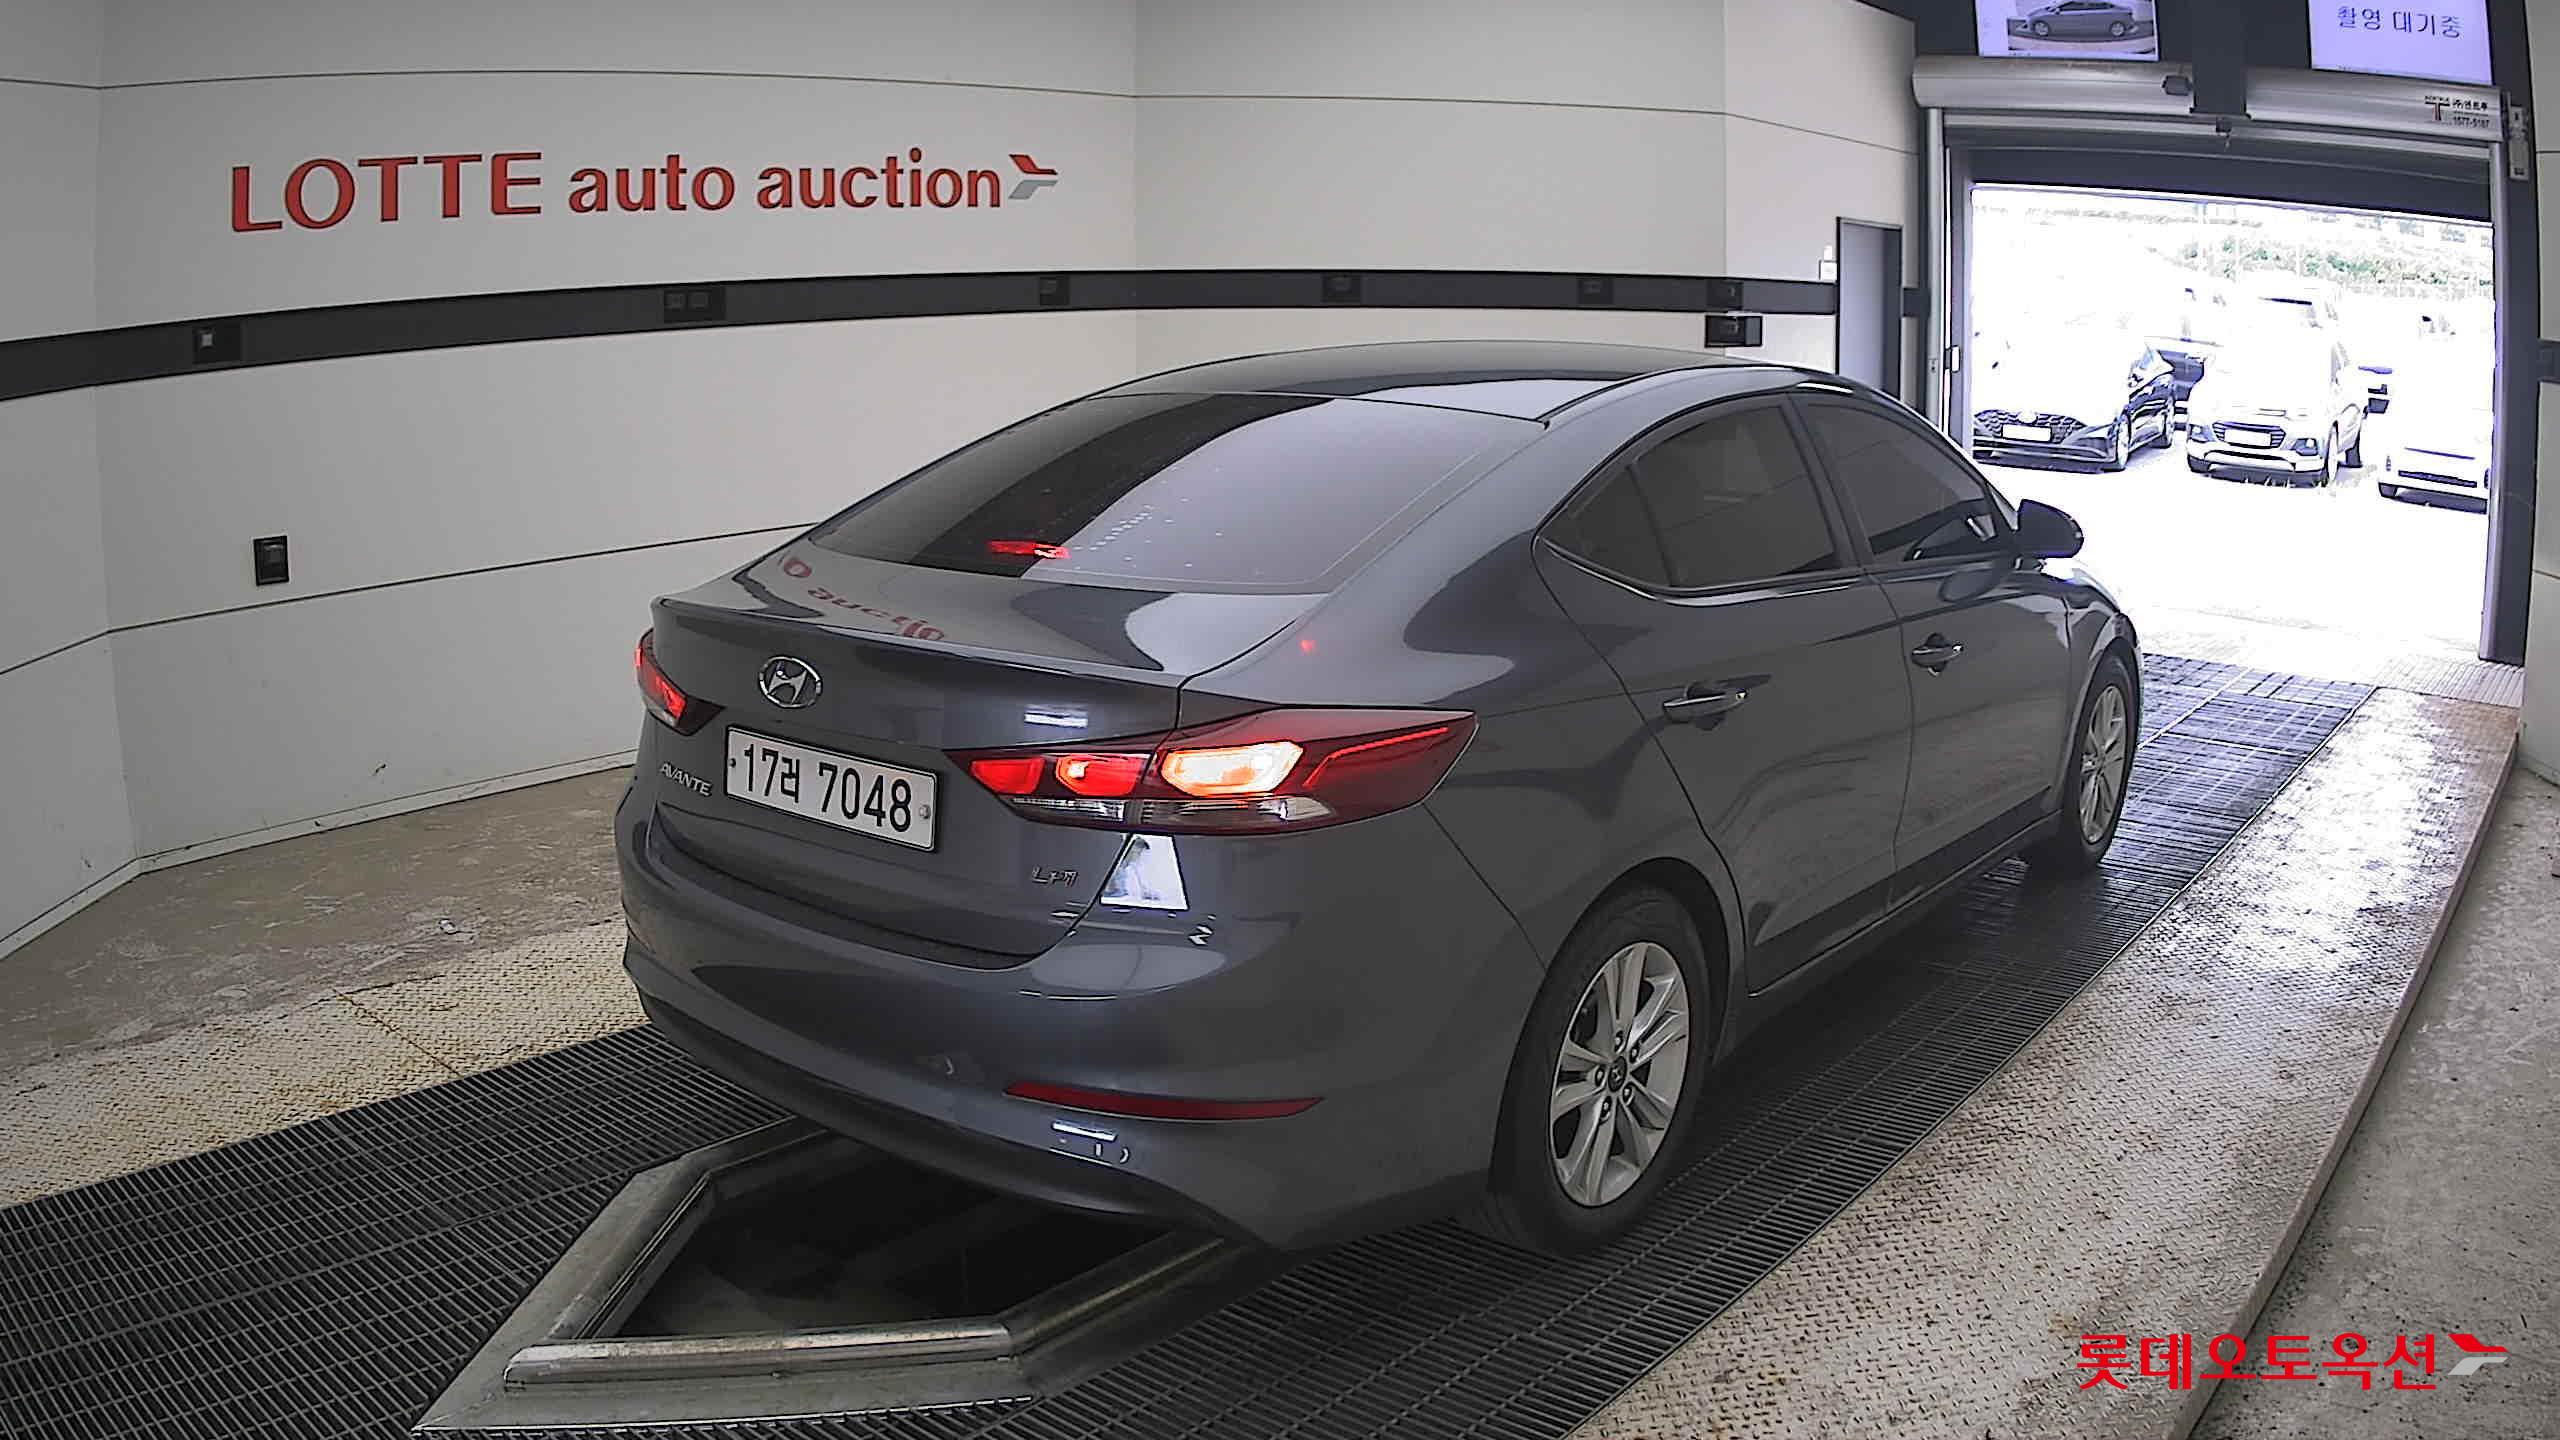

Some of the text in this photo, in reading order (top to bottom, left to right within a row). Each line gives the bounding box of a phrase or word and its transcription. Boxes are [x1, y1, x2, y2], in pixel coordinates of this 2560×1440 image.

[2338, 6, 2382, 31] 촬영
[231, 147, 1001, 232] LOTTE auto auction
[659, 761, 714, 797] AVANTE
[744, 743, 912, 833] 17러 7048
